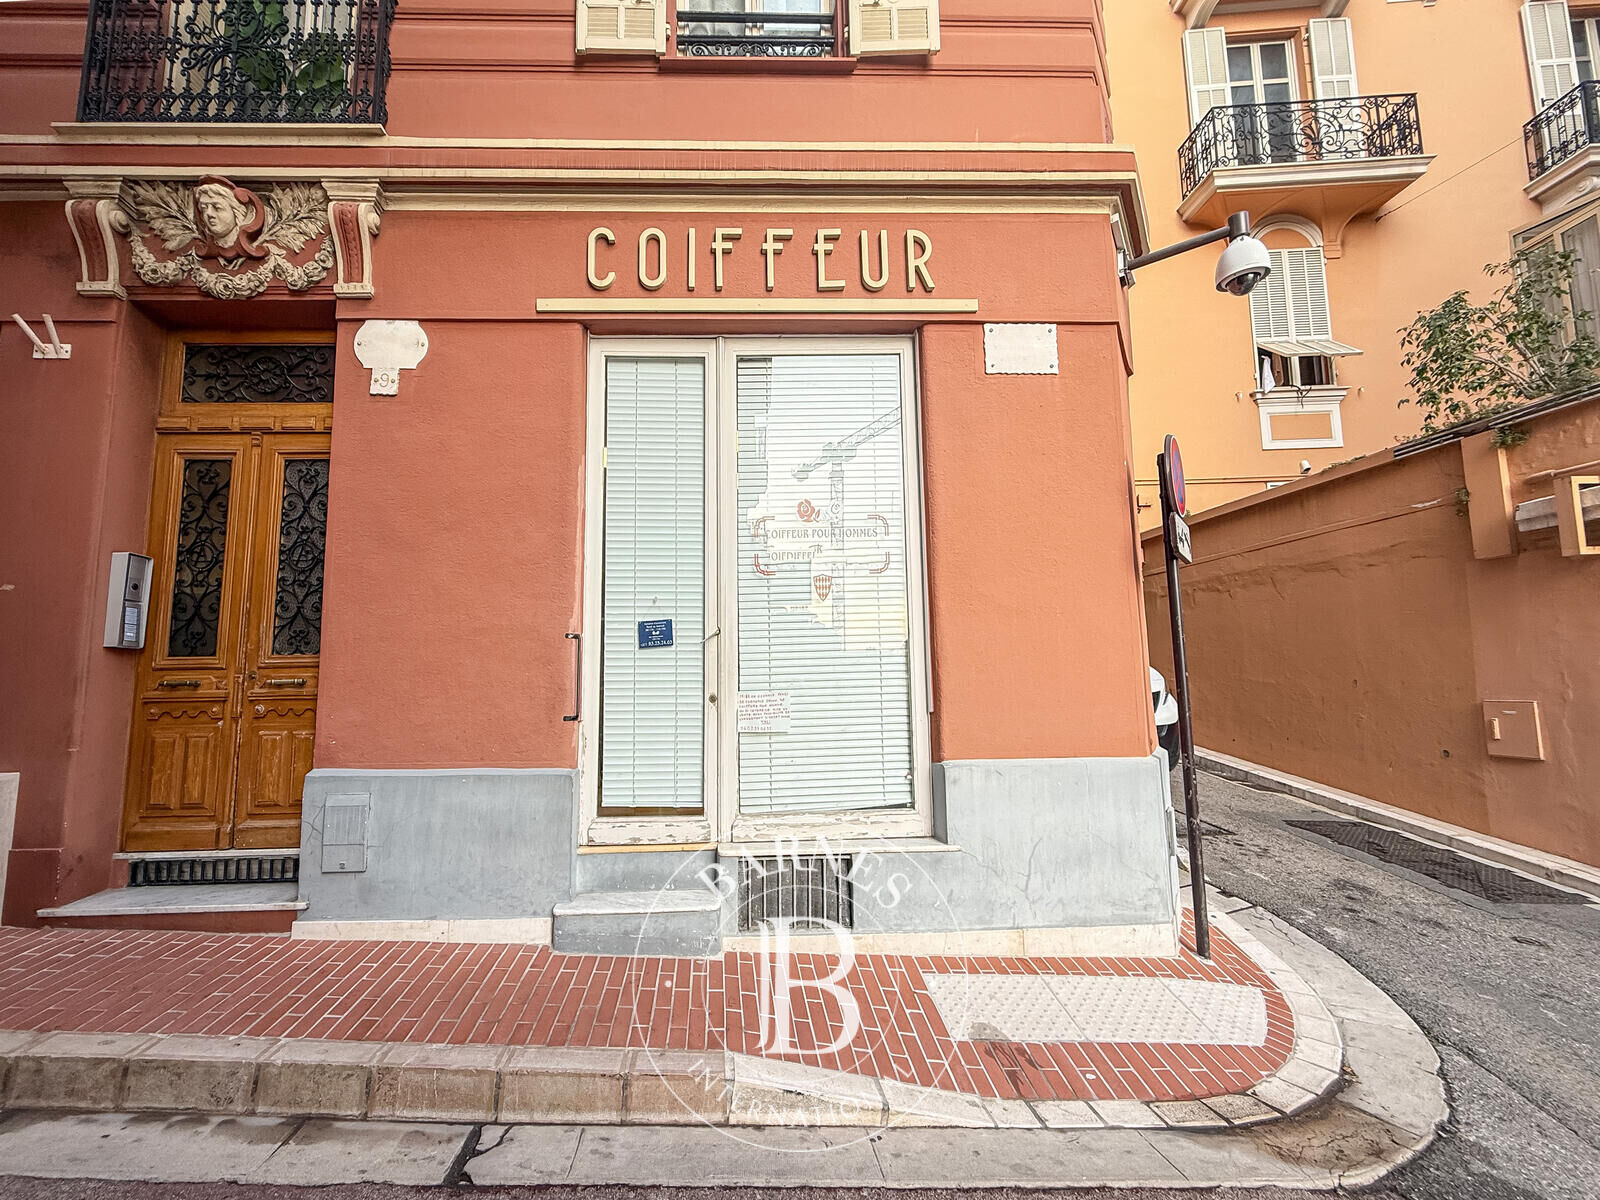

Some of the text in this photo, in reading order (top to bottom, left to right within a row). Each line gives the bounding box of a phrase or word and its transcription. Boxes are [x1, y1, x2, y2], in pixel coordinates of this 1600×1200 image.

[587, 226, 935, 292] COIFFEUR
[379, 373, 390, 388] 9
[812, 528, 836, 539] POUR
